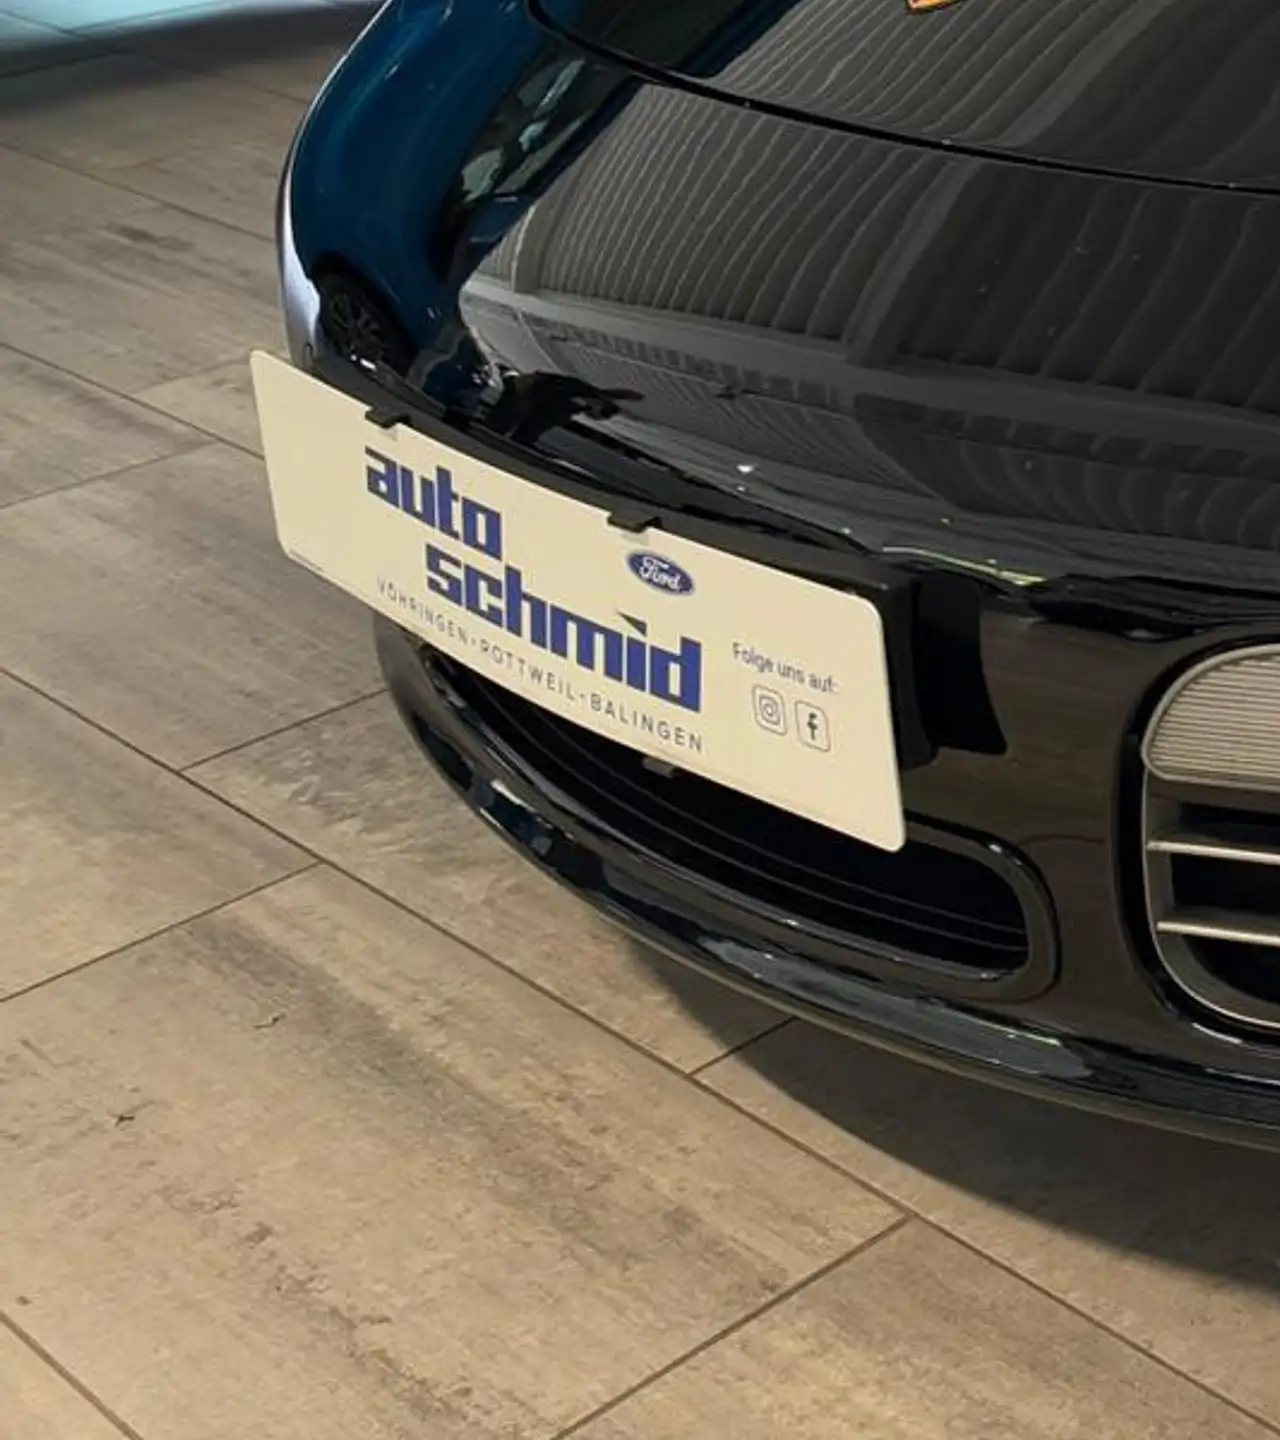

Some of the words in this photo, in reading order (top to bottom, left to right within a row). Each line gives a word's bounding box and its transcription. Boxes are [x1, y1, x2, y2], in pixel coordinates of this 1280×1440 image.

[365, 445, 502, 562] auto
[637, 554, 684, 592] Ford
[426, 543, 702, 714] schmid
[732, 641, 774, 673] Folge
[777, 662, 806, 684] uns
